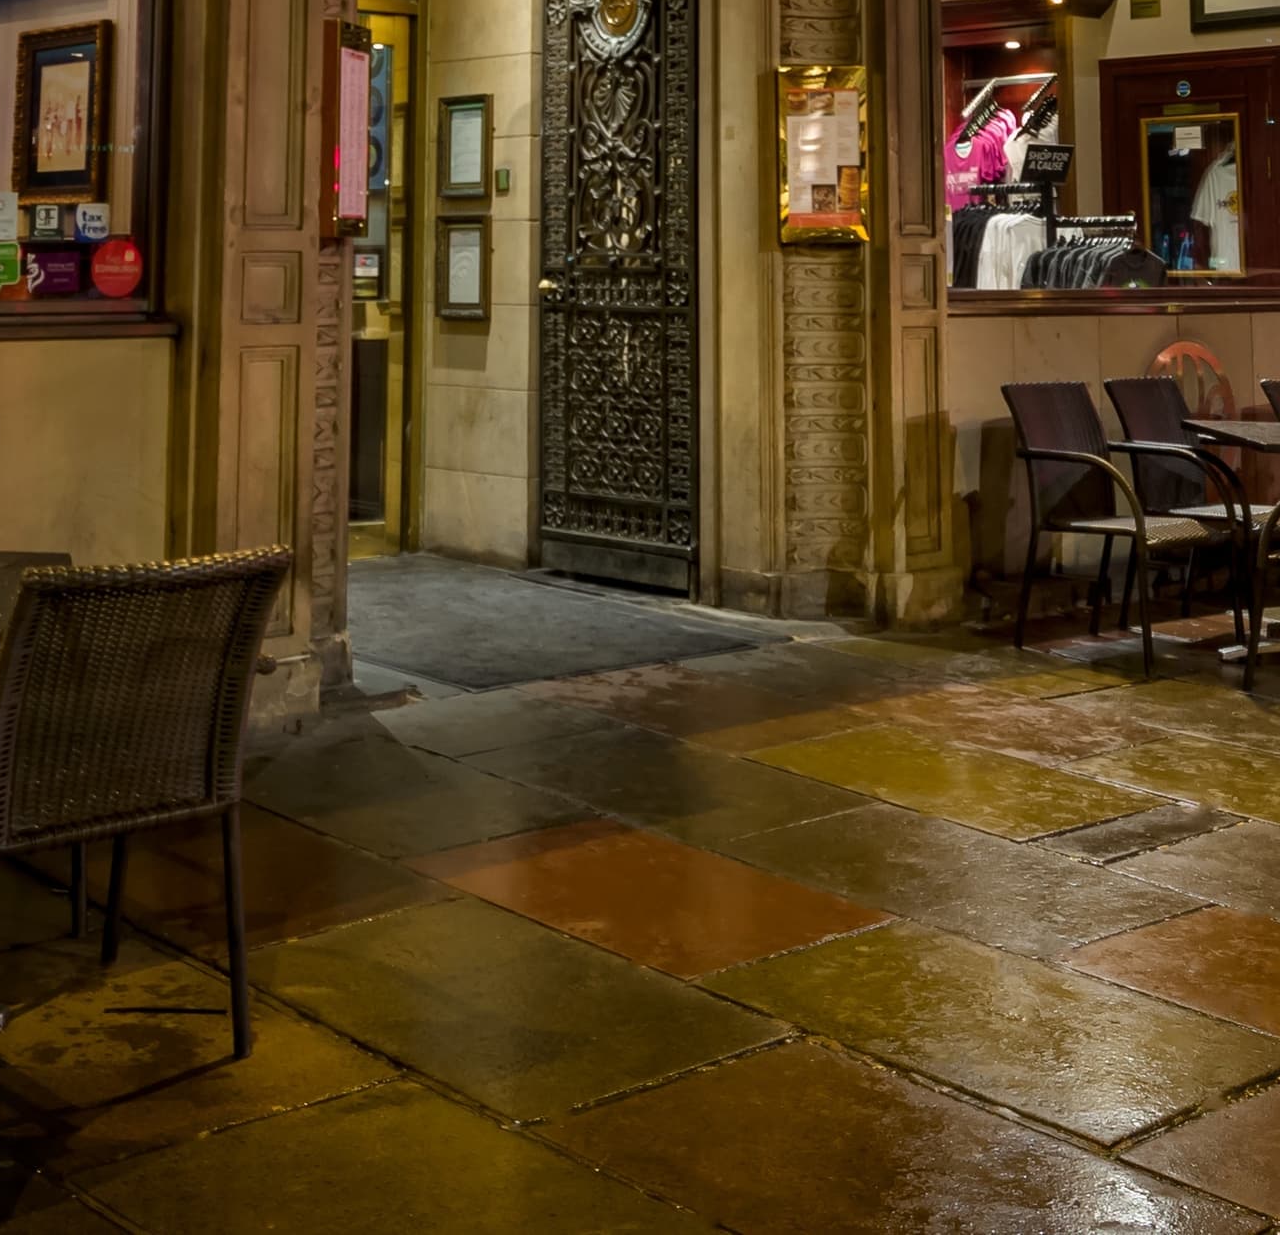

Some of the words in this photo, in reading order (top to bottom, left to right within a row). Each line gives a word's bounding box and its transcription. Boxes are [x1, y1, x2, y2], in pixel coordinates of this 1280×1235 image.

[1028, 151, 1052, 161] SHOP
[1052, 152, 1070, 162] FOR
[1028, 160, 1036, 170] A
[1036, 160, 1065, 171] CAUSE
[82, 210, 102, 222] tax
[82, 223, 106, 235] free
